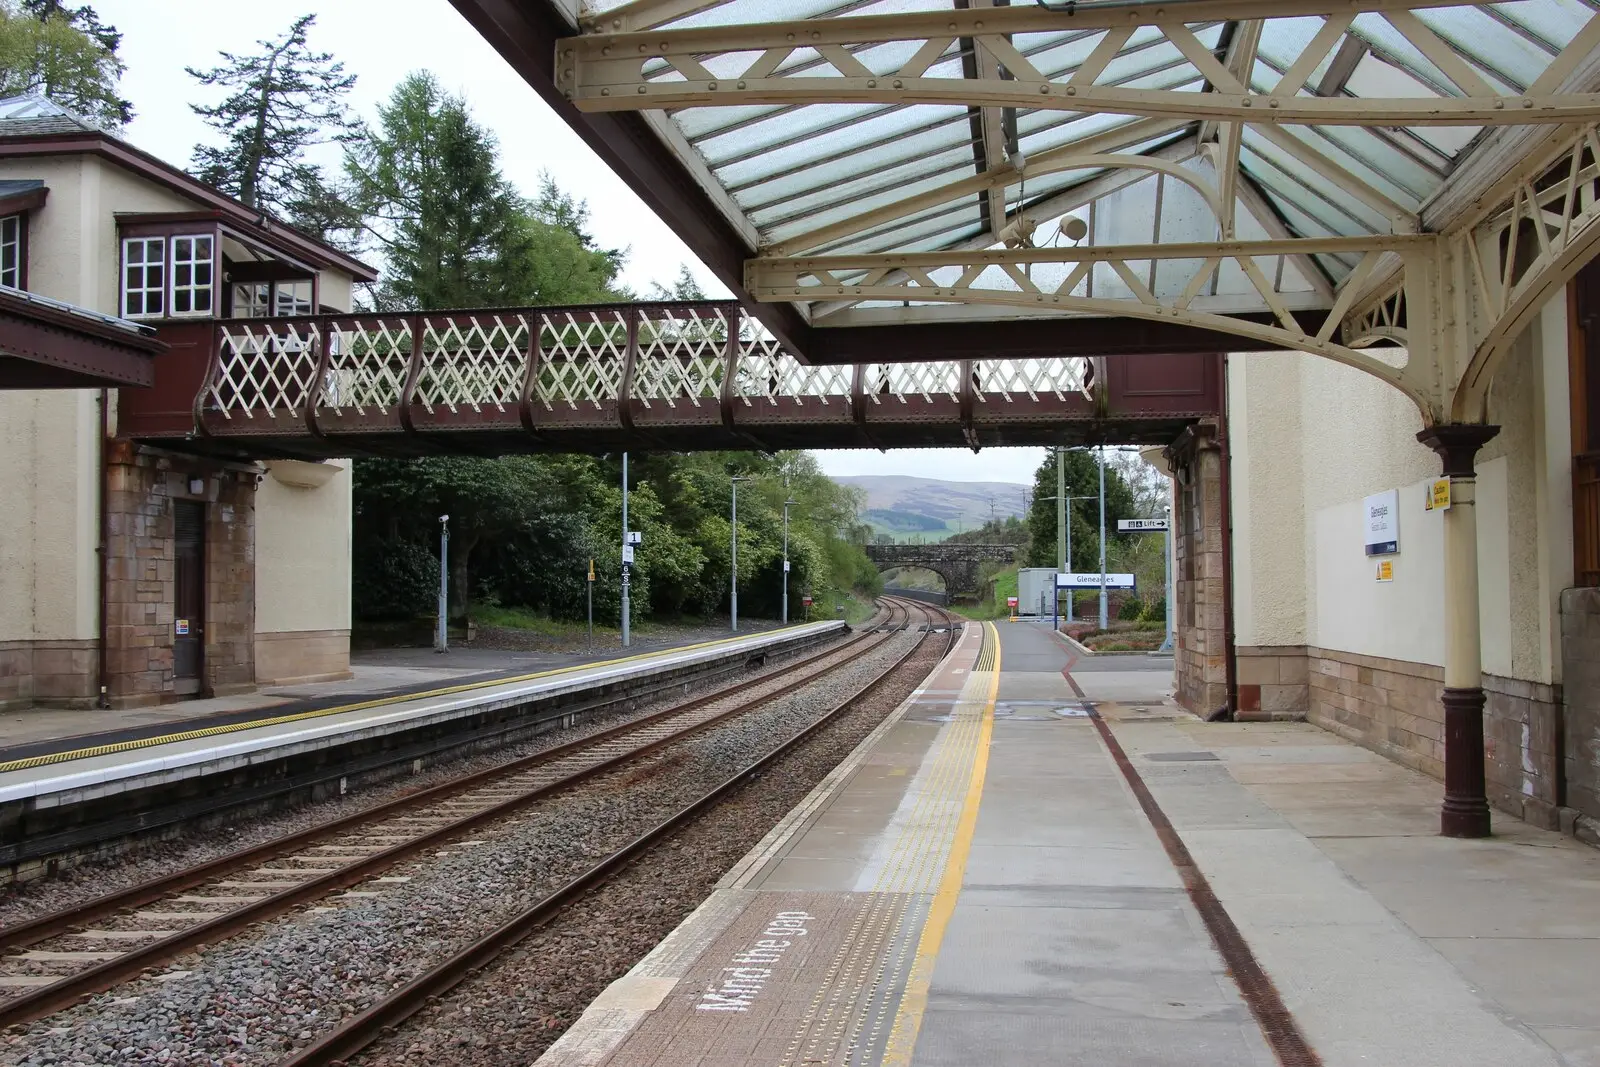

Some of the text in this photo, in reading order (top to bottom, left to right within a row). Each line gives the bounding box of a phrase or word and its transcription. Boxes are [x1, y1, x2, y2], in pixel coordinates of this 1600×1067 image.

[632, 533, 636, 542] 1
[696, 911, 816, 1012] Mind the gap
